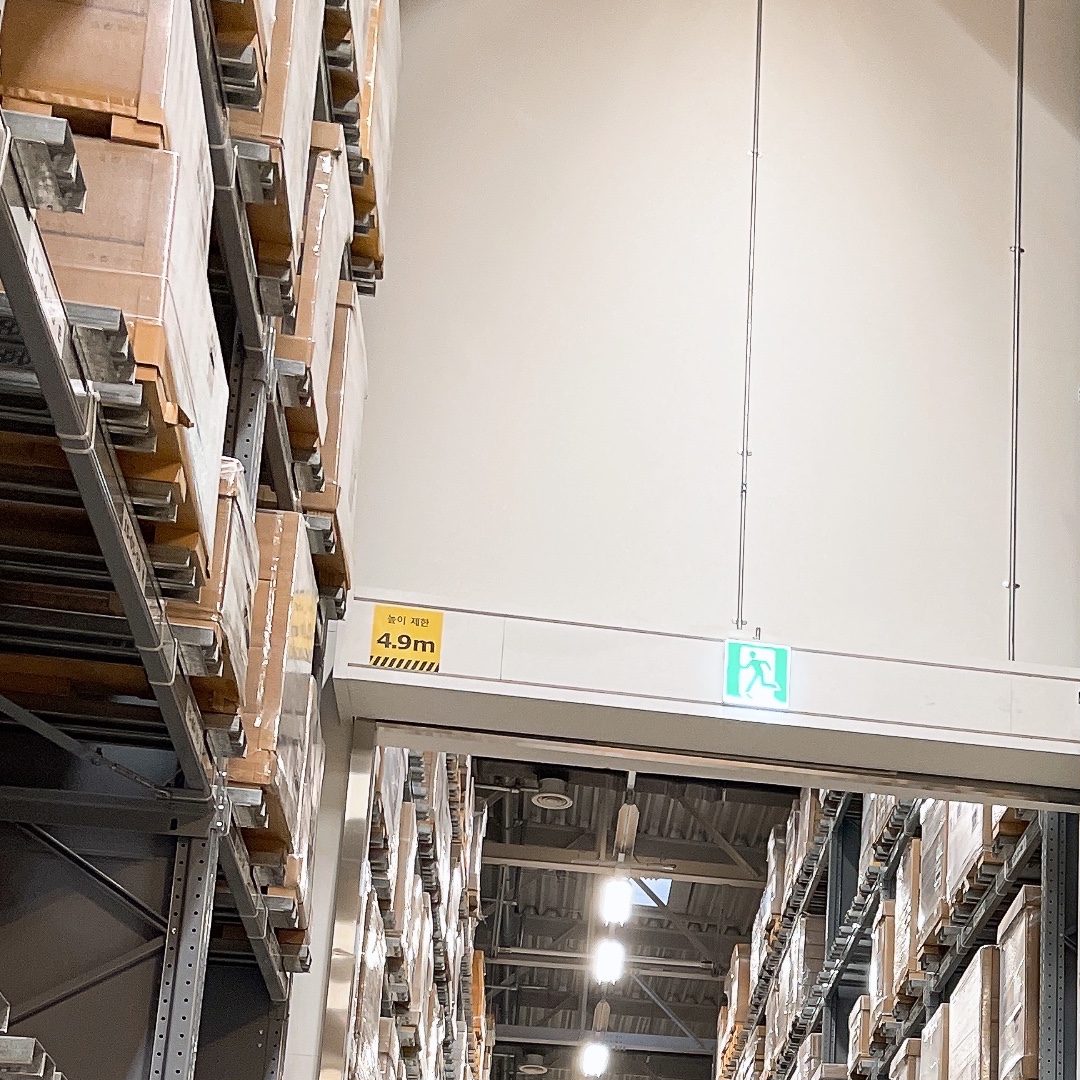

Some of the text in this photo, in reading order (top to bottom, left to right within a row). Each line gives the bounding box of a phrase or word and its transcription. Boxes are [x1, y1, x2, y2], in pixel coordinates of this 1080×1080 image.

[387, 614, 429, 627] 높이 제한
[376, 632, 435, 653] 4.9m
